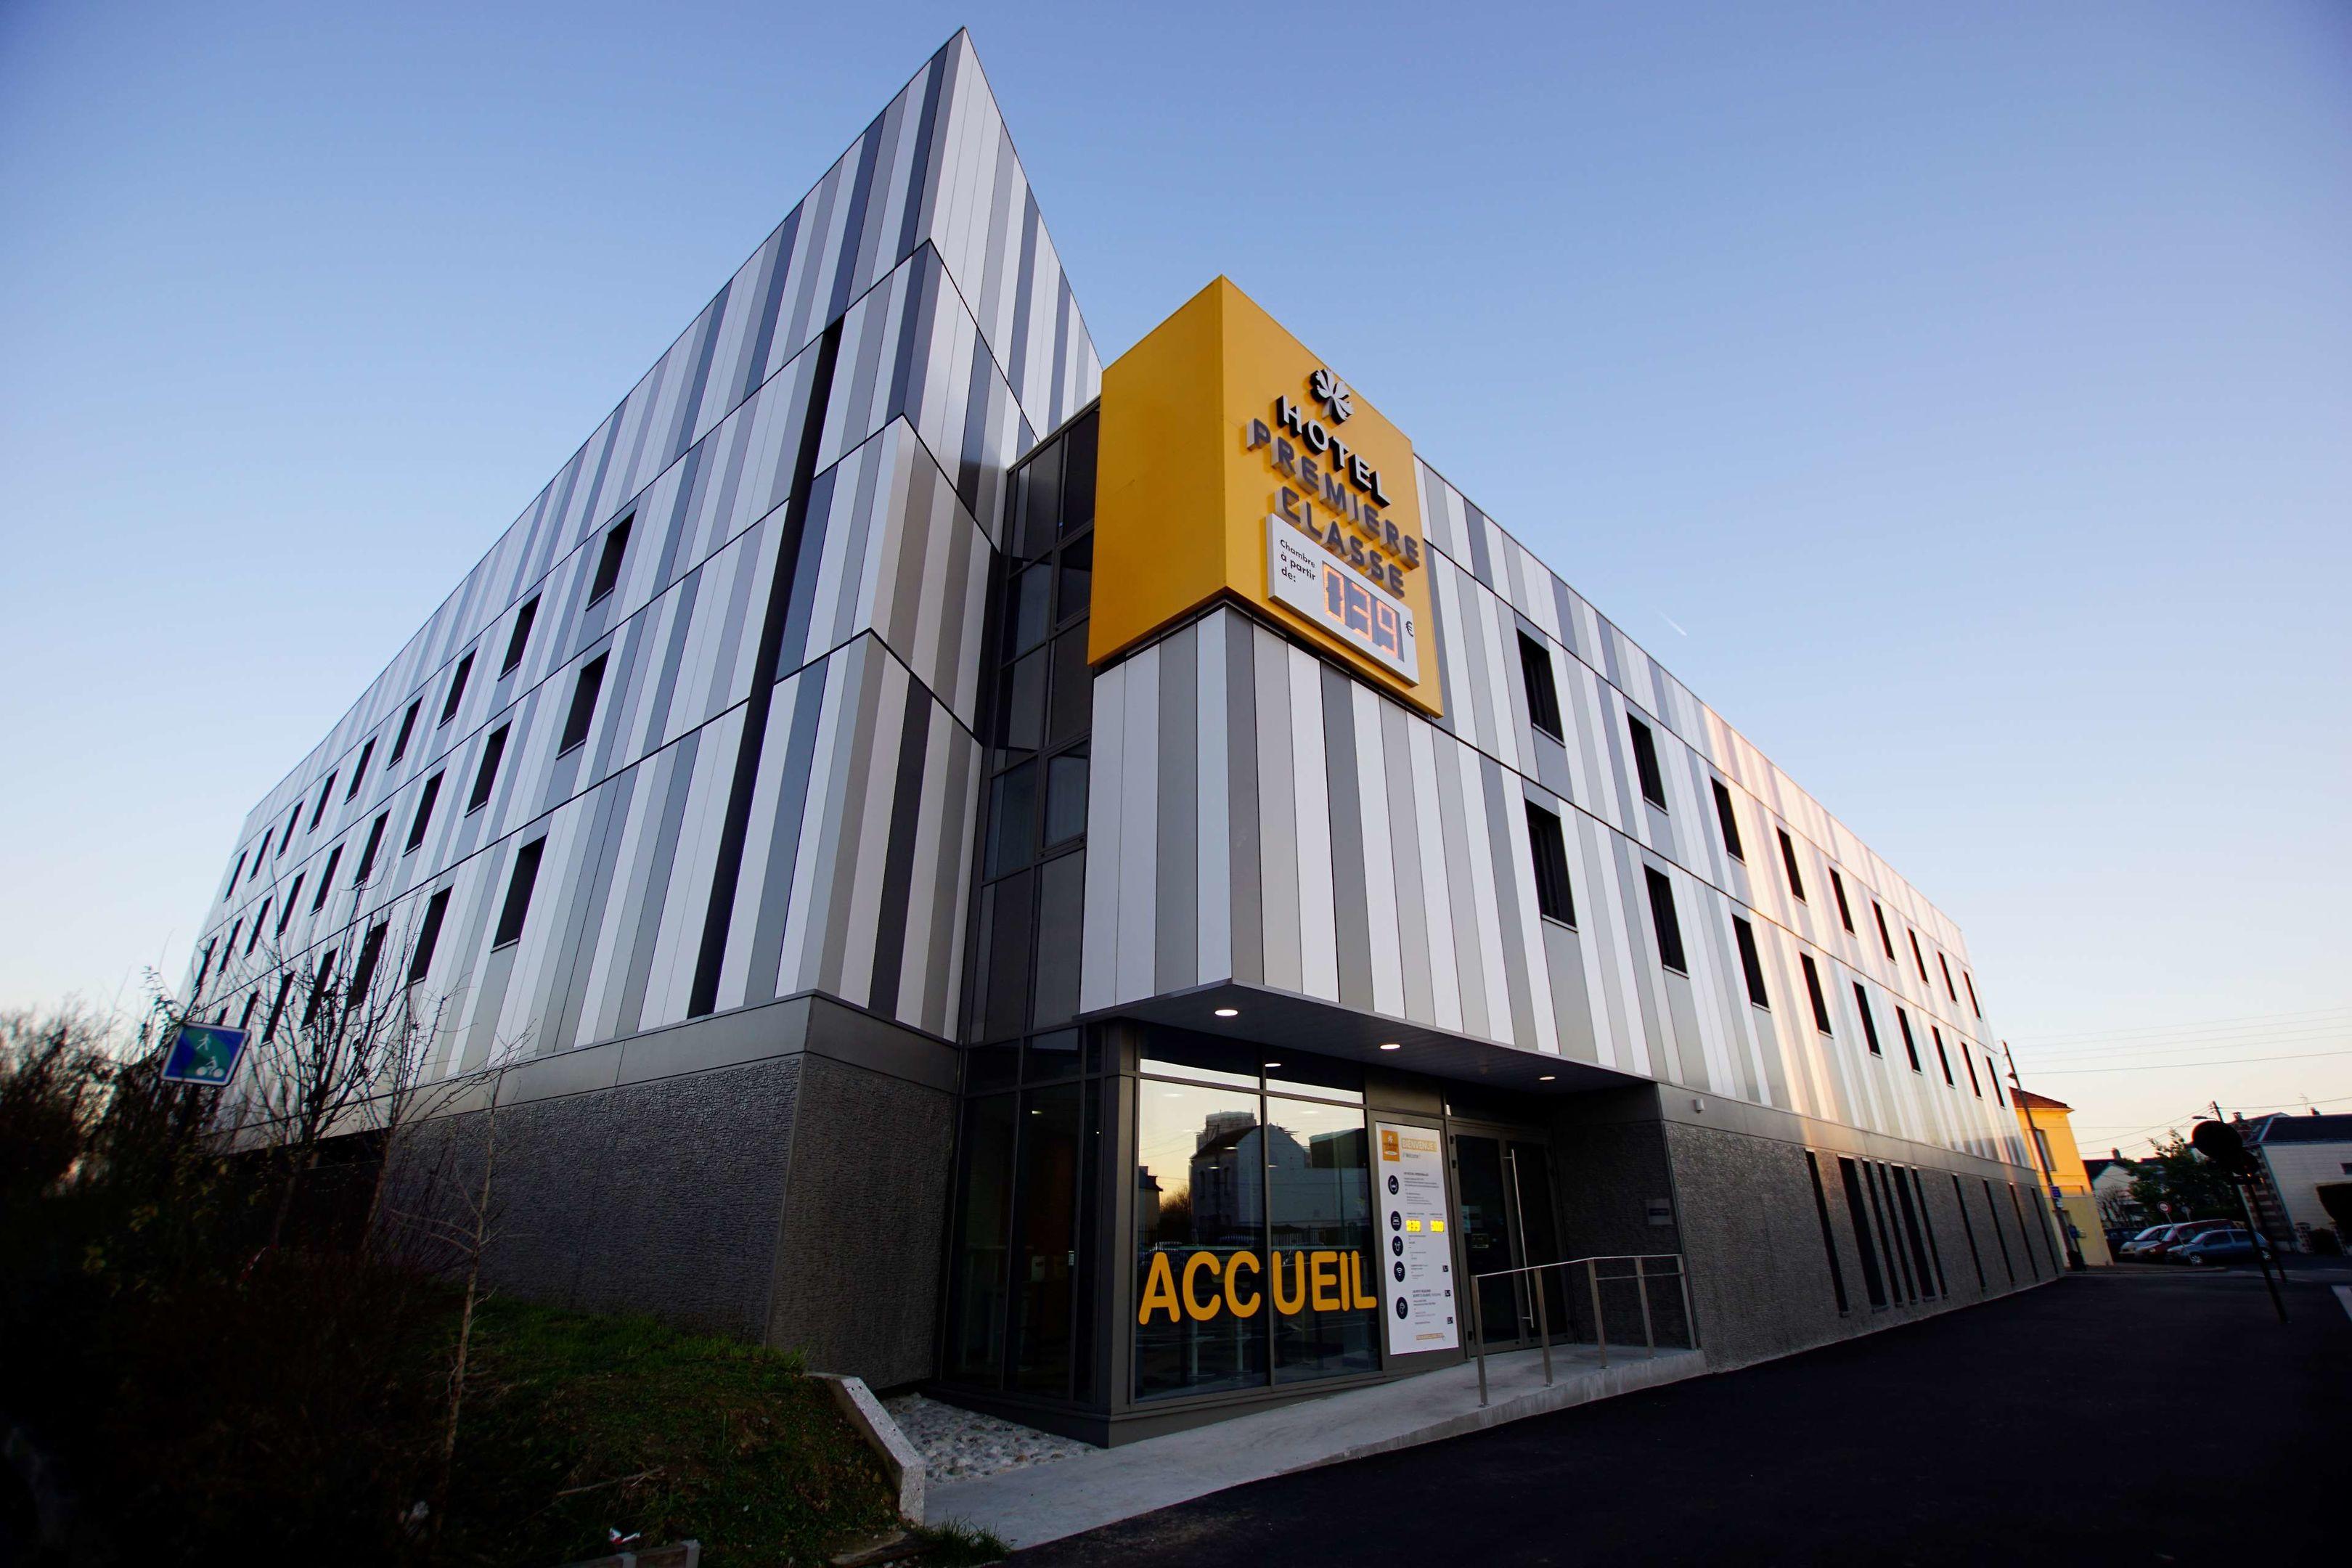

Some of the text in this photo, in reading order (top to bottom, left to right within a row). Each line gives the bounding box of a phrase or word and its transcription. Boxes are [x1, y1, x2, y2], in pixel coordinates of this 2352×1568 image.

[1277, 395, 1391, 507] HOTEL
[1247, 418, 1420, 569] PREMIERE
[1275, 486, 1405, 599] CLASSE
[1280, 539, 1315, 568] Chambre
[1281, 552, 1316, 581] à partir
[1281, 567, 1296, 582] de:
[1405, 620, 1414, 637] €
[1138, 1251, 1377, 1318] ACCUEIL
